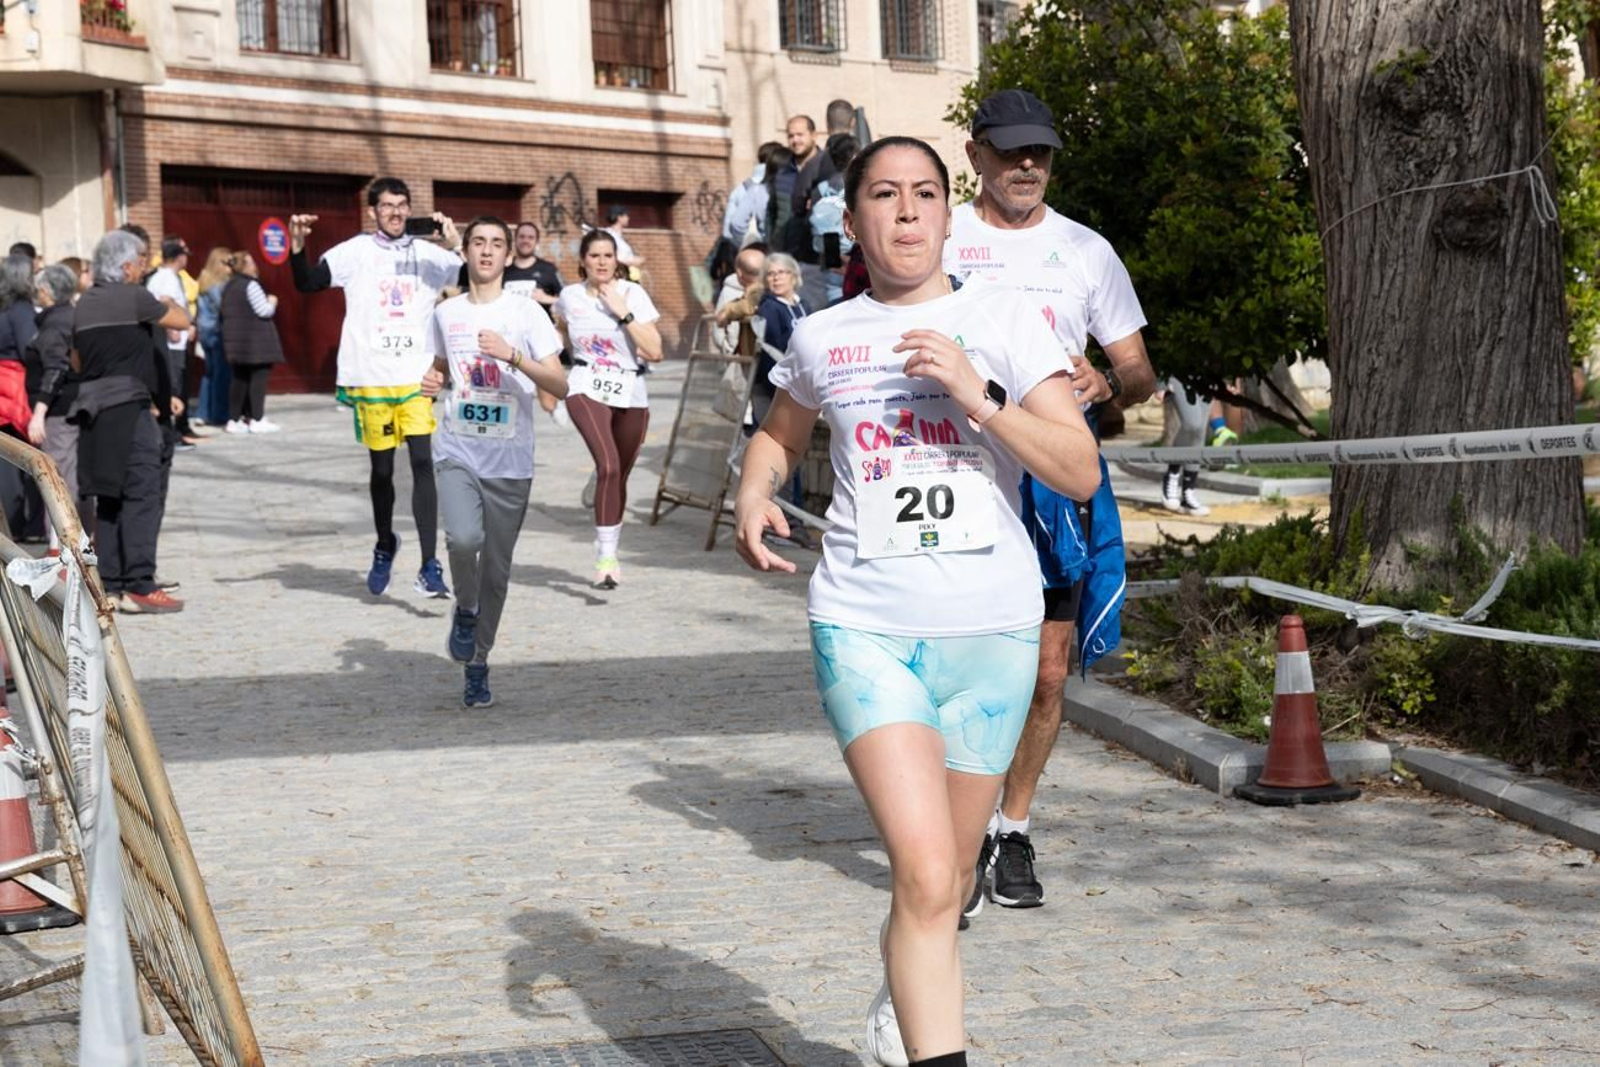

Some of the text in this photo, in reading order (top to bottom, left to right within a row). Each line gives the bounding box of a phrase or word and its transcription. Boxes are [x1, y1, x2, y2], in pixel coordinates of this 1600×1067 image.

[958, 247, 992, 261] XXVII
[382, 336, 413, 348] 373
[828, 345, 872, 367] XXVII
[593, 379, 623, 395] 952
[463, 404, 502, 423] 631
[1540, 436, 1576, 450] DEPORTES
[895, 484, 954, 523] 20
